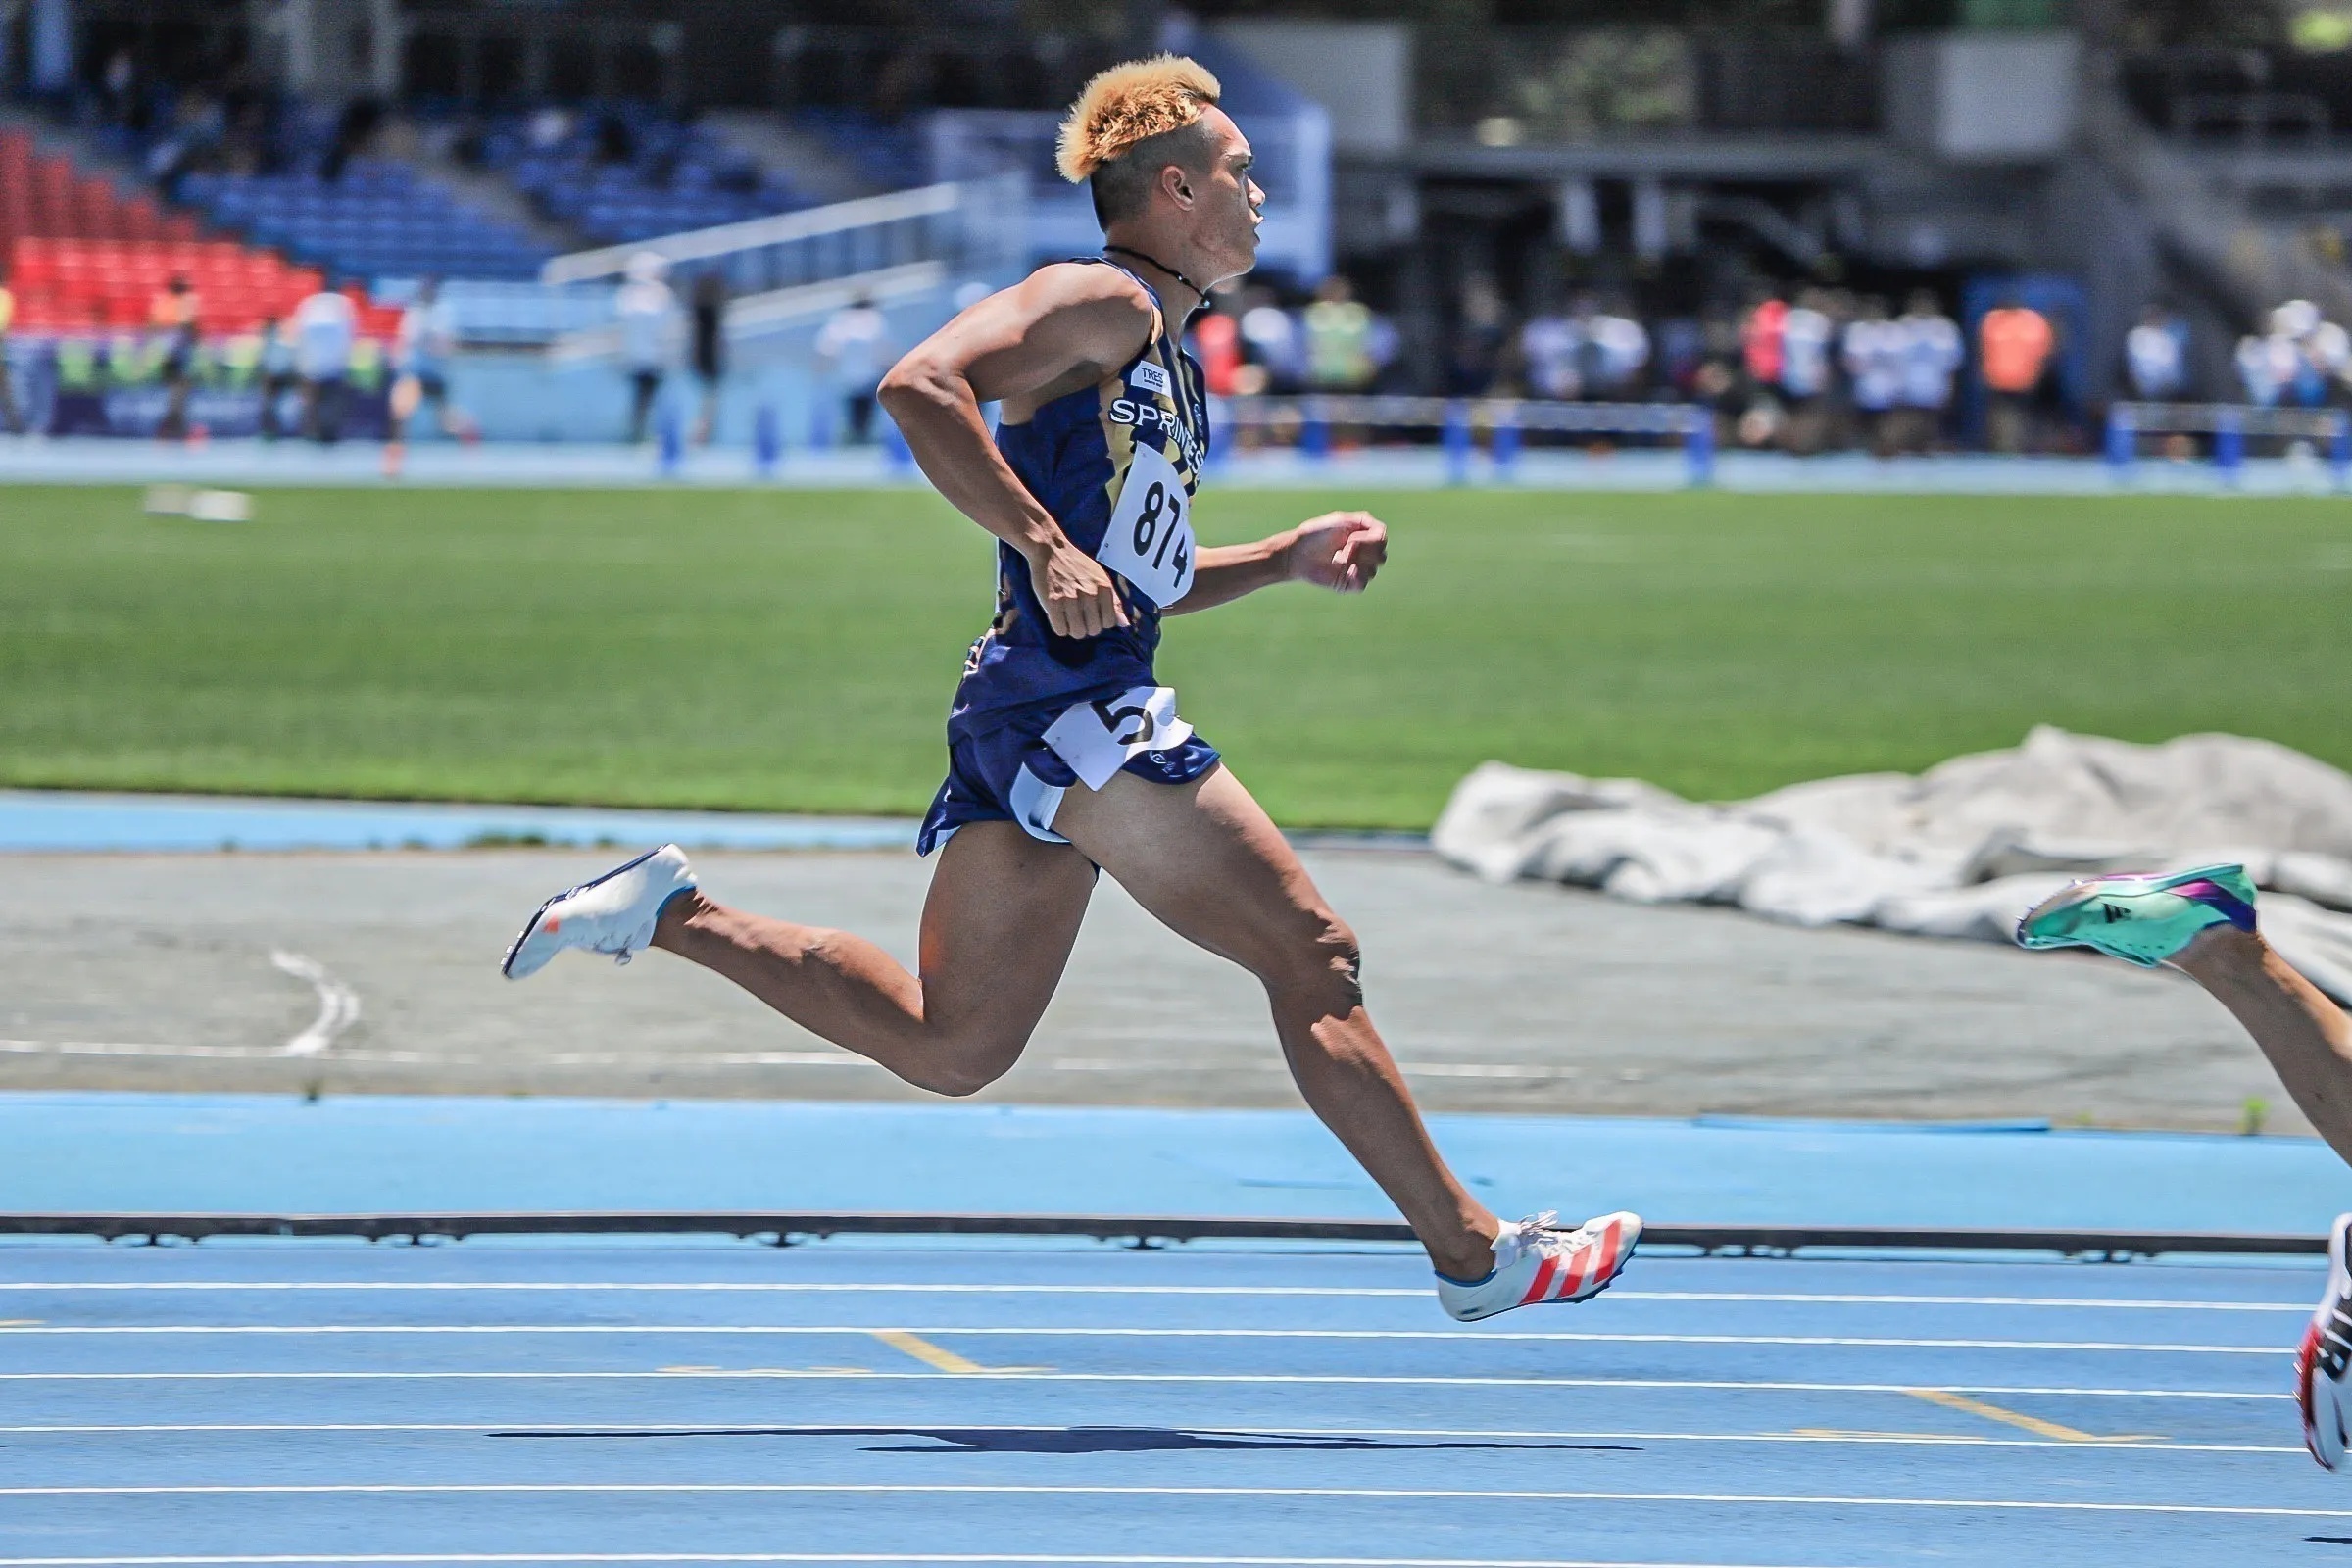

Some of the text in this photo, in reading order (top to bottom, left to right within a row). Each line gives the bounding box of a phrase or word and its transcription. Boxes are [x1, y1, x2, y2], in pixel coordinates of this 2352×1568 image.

[1140, 367, 1164, 383] TRES
[1133, 481, 1188, 588] 874
[1089, 691, 1154, 746] 5
